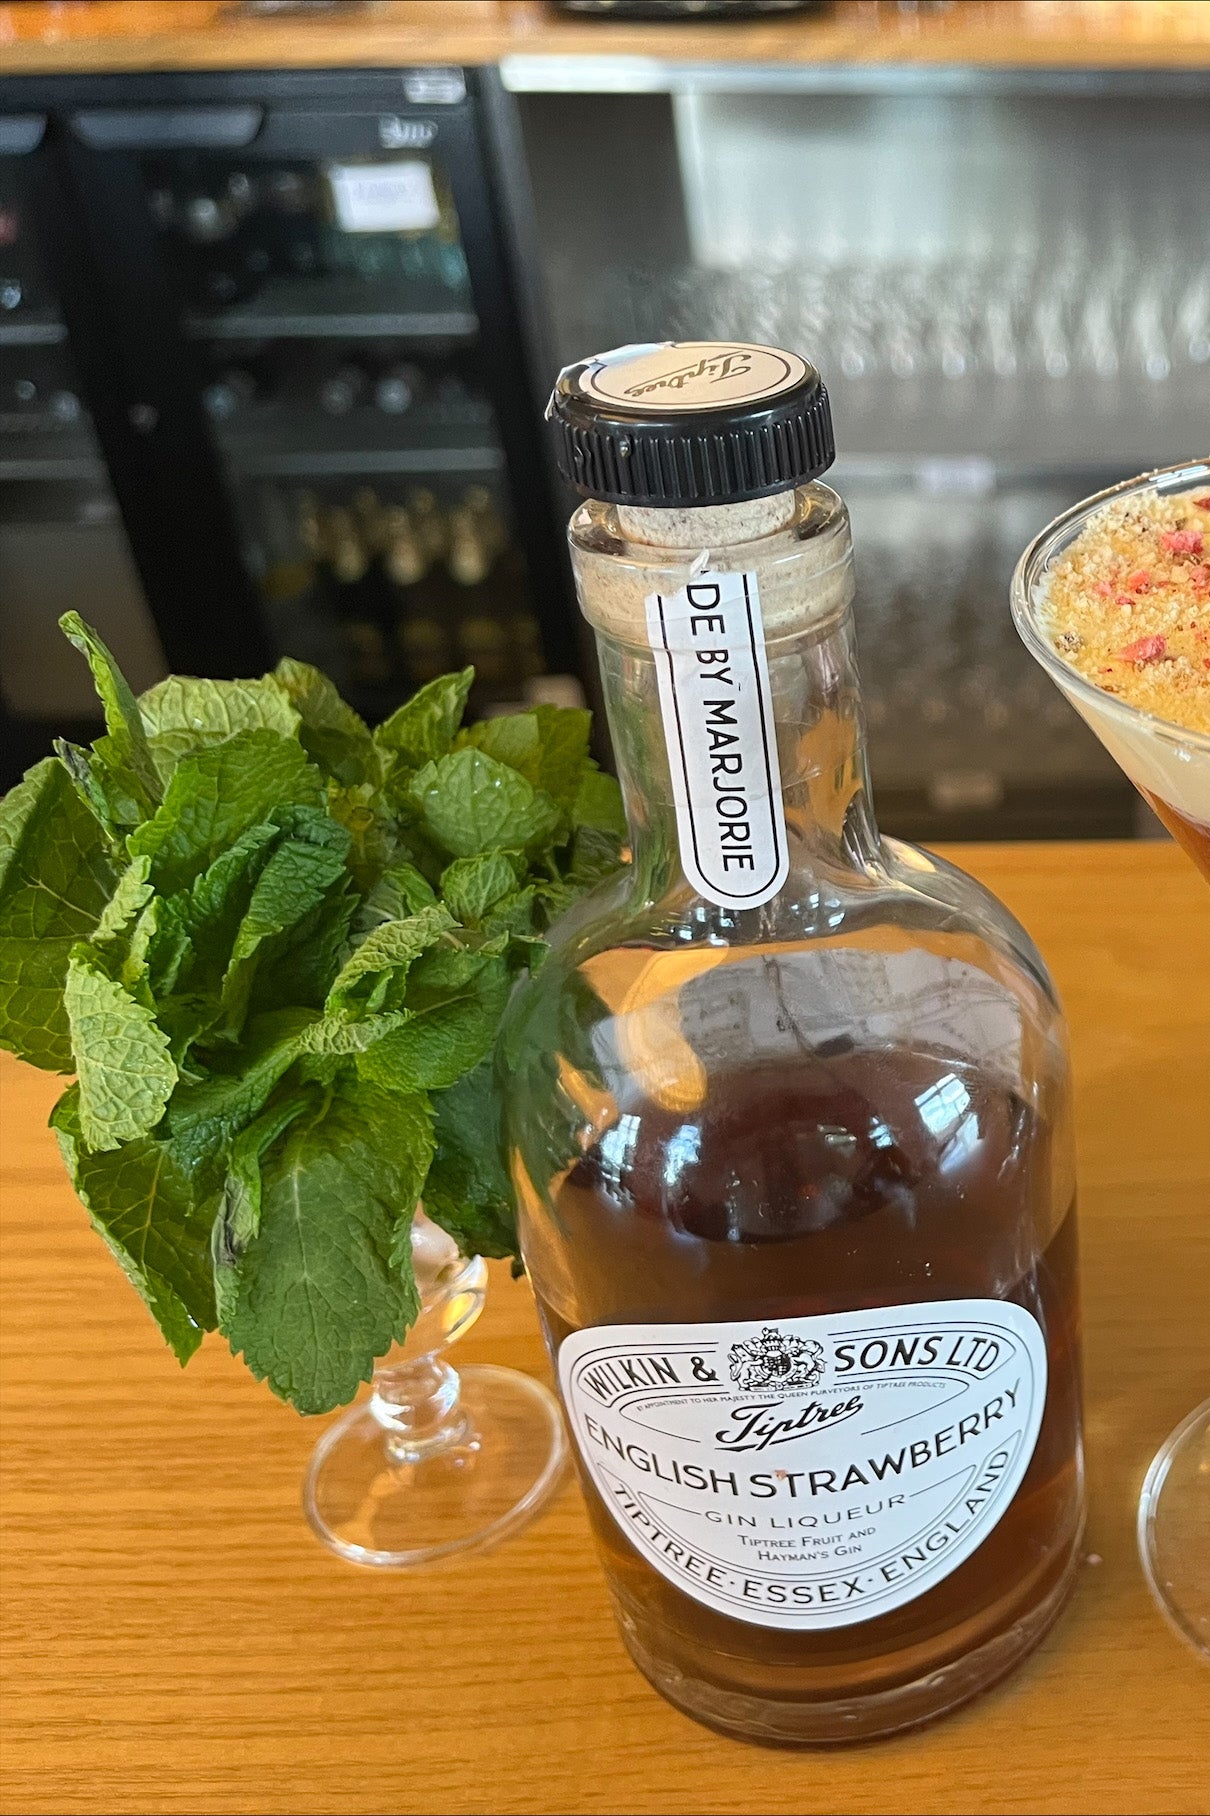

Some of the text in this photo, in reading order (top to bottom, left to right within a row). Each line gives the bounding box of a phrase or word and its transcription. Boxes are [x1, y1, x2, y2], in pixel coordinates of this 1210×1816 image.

[623, 350, 752, 397] Tiptree
[686, 570, 755, 872] DE BY MARJORIE
[583, 1335, 1001, 1401] WILKIN & SONS LTD
[644, 1398, 689, 1410] APPOINTMENT
[703, 1396, 718, 1404] HER
[721, 1393, 756, 1403] MAJESTY
[777, 1390, 808, 1399] QUEEN
[810, 1385, 861, 1396] PURVEYORS
[862, 1383, 874, 1391] OF
[876, 1381, 906, 1390] TIPTREE
[907, 1380, 946, 1390] PRODUCTS
[583, 1377, 1021, 1499] ENGLISH STRAWBERRY
[715, 1395, 864, 1452] Tiptree
[612, 1448, 1010, 1605] TIPTREE ESSEX ENGLAND
[705, 1494, 906, 1529] GIN LIQUEUR
[849, 1526, 877, 1541] AND
